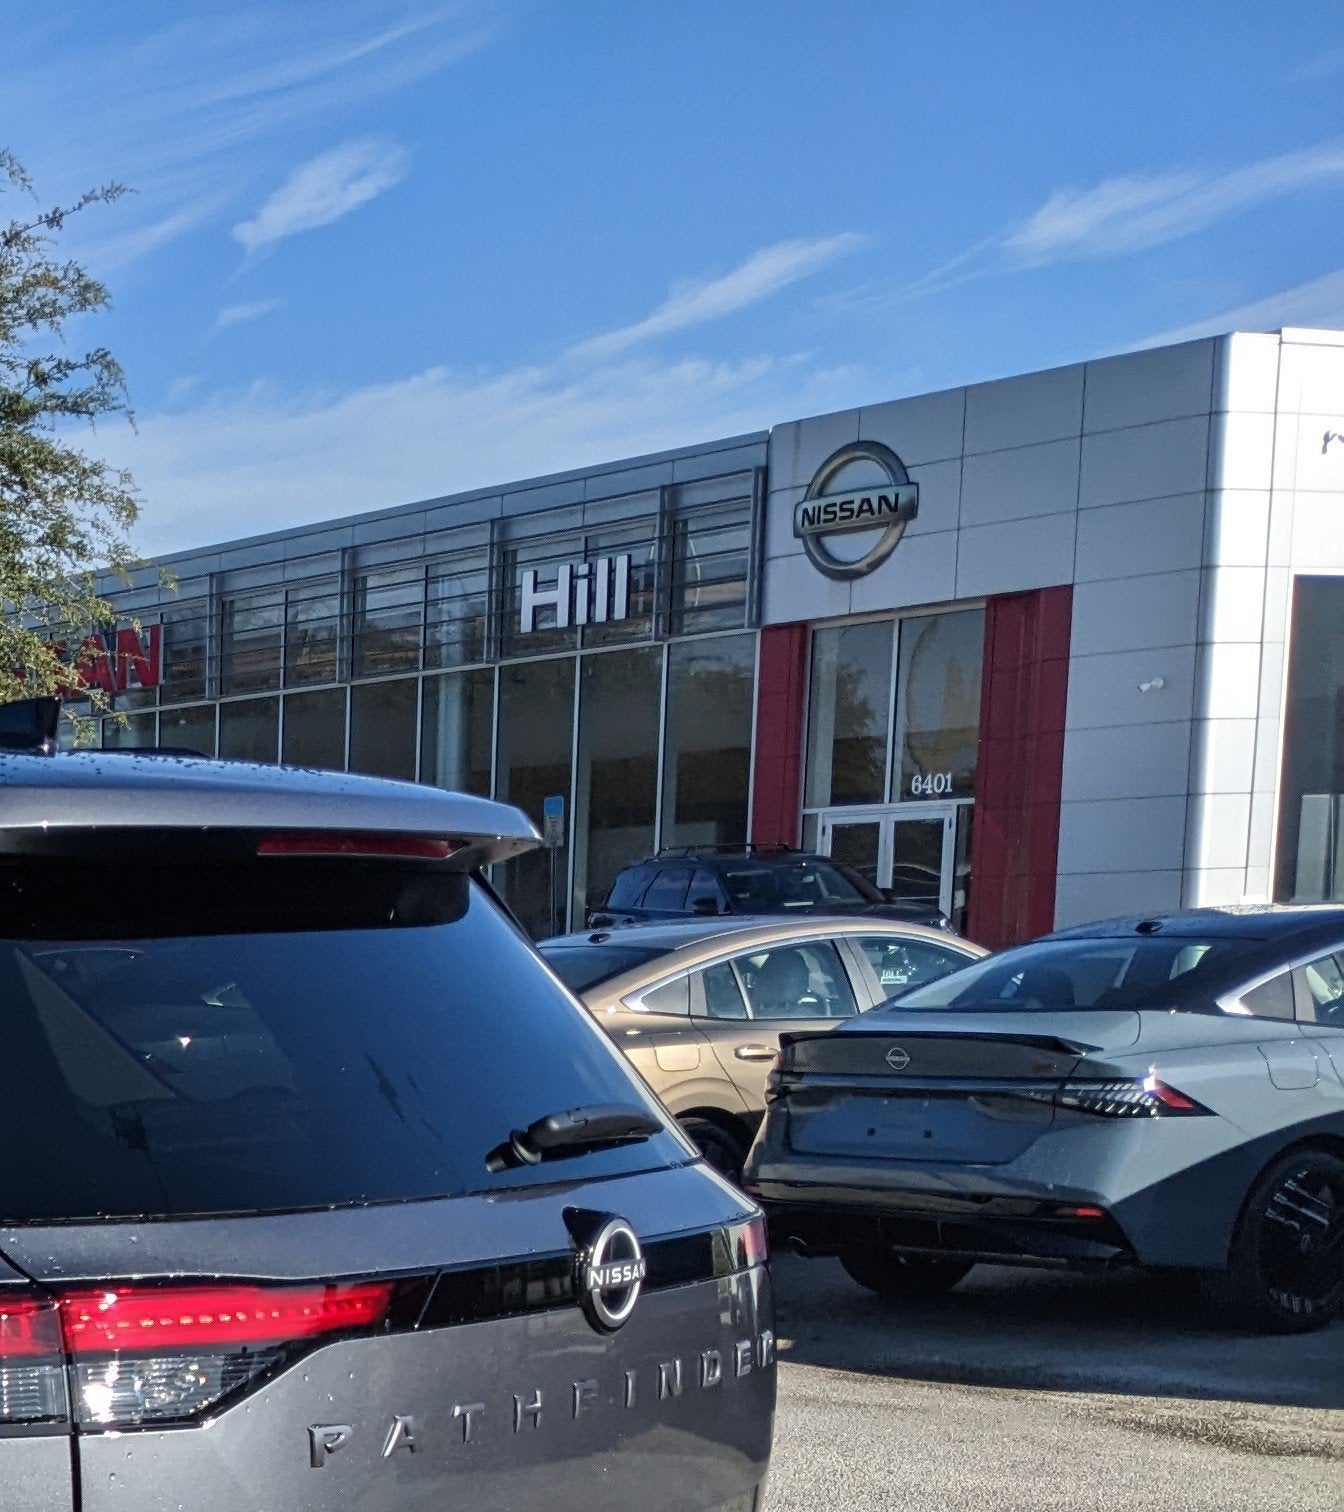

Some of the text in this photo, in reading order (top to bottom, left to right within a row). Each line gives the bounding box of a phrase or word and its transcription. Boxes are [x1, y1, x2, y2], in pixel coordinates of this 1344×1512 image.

[800, 492, 900, 528] NISSAN
[520, 554, 631, 634] Hill
[911, 772, 953, 795] 6401
[590, 1262, 646, 1287] NISSAN
[307, 1330, 775, 1468] PATHFINDER
